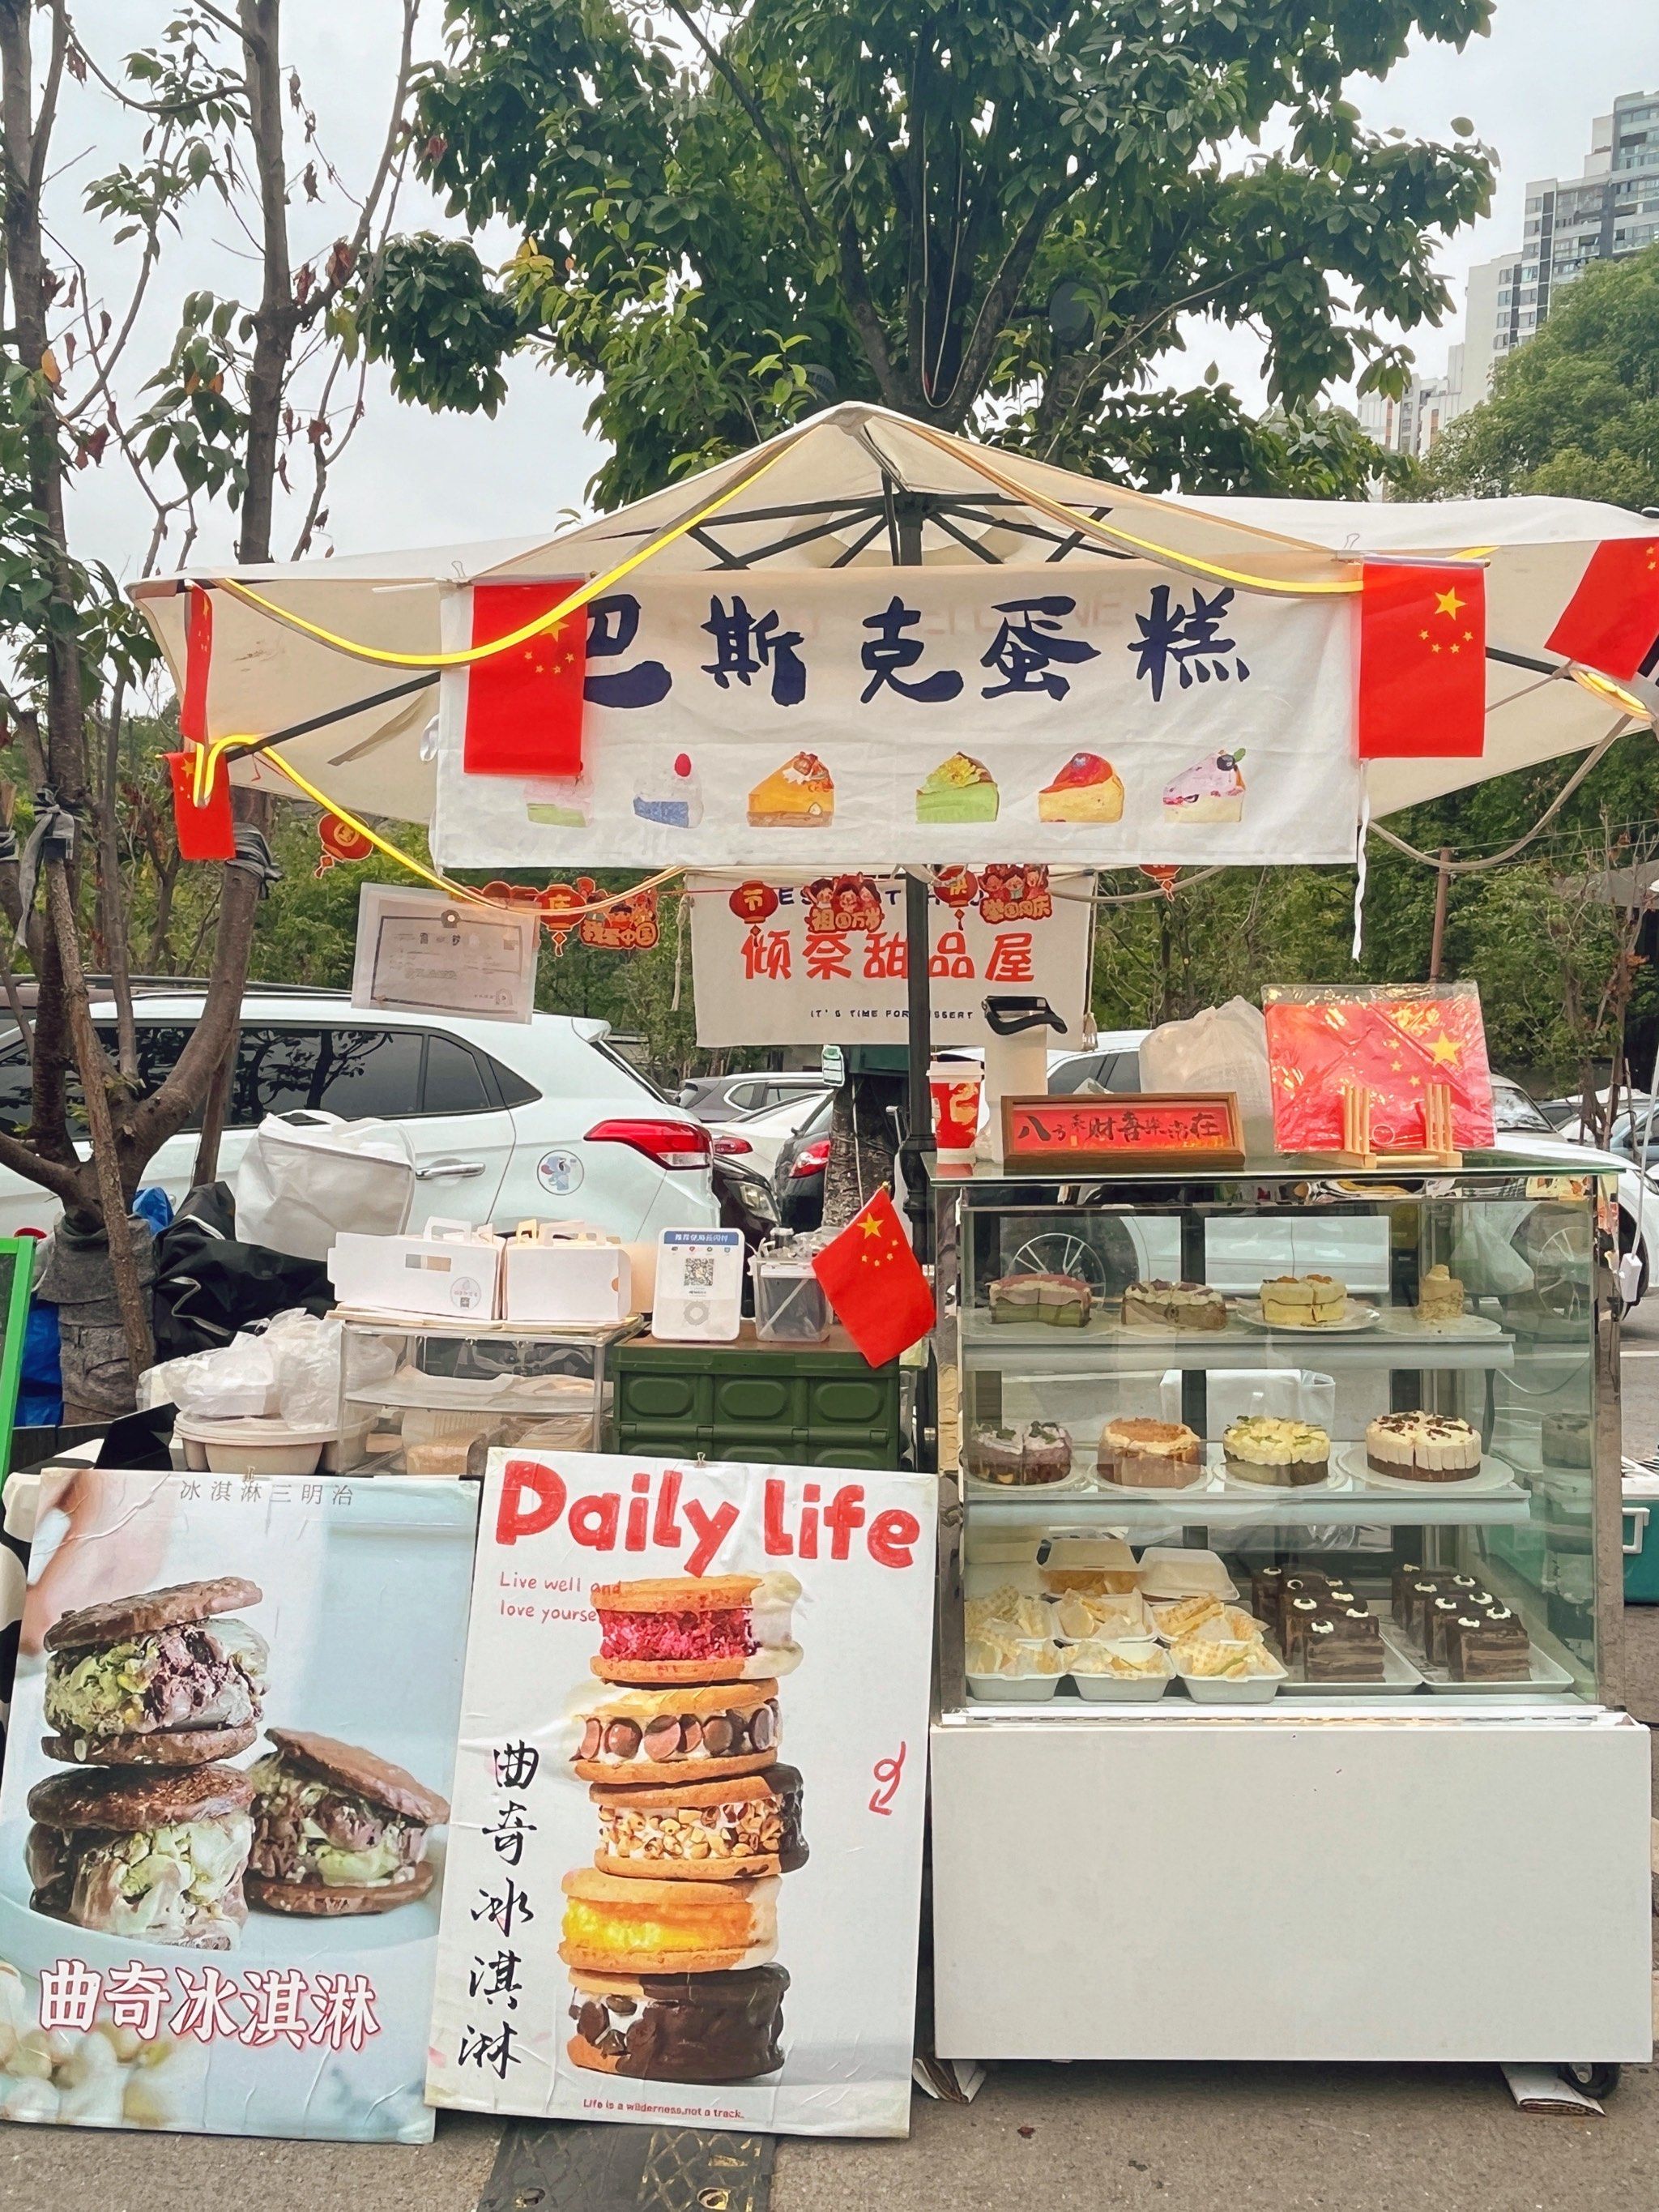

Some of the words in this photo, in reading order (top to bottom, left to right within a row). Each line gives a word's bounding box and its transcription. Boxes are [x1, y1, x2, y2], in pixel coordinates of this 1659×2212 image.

[584, 584, 1250, 709] 巴斯克蛋糕
[851, 1010, 878, 1018] TIME
[885, 1010, 910, 1018] FOR
[180, 1480, 353, 1506] 冰淇淋三明治
[496, 1460, 740, 1578] Daily
[500, 1571, 537, 1590] Live
[544, 1577, 581, 1592] well
[591, 1580, 621, 1595] and
[500, 1599, 535, 1617] love
[541, 1608, 597, 1624] yourse
[457, 1739, 539, 2080] 曲奇冰淇淋
[39, 1958, 381, 2051] 曲奇冰淇淋
[582, 2099, 603, 2109] Life
[605, 2100, 614, 2110] is
